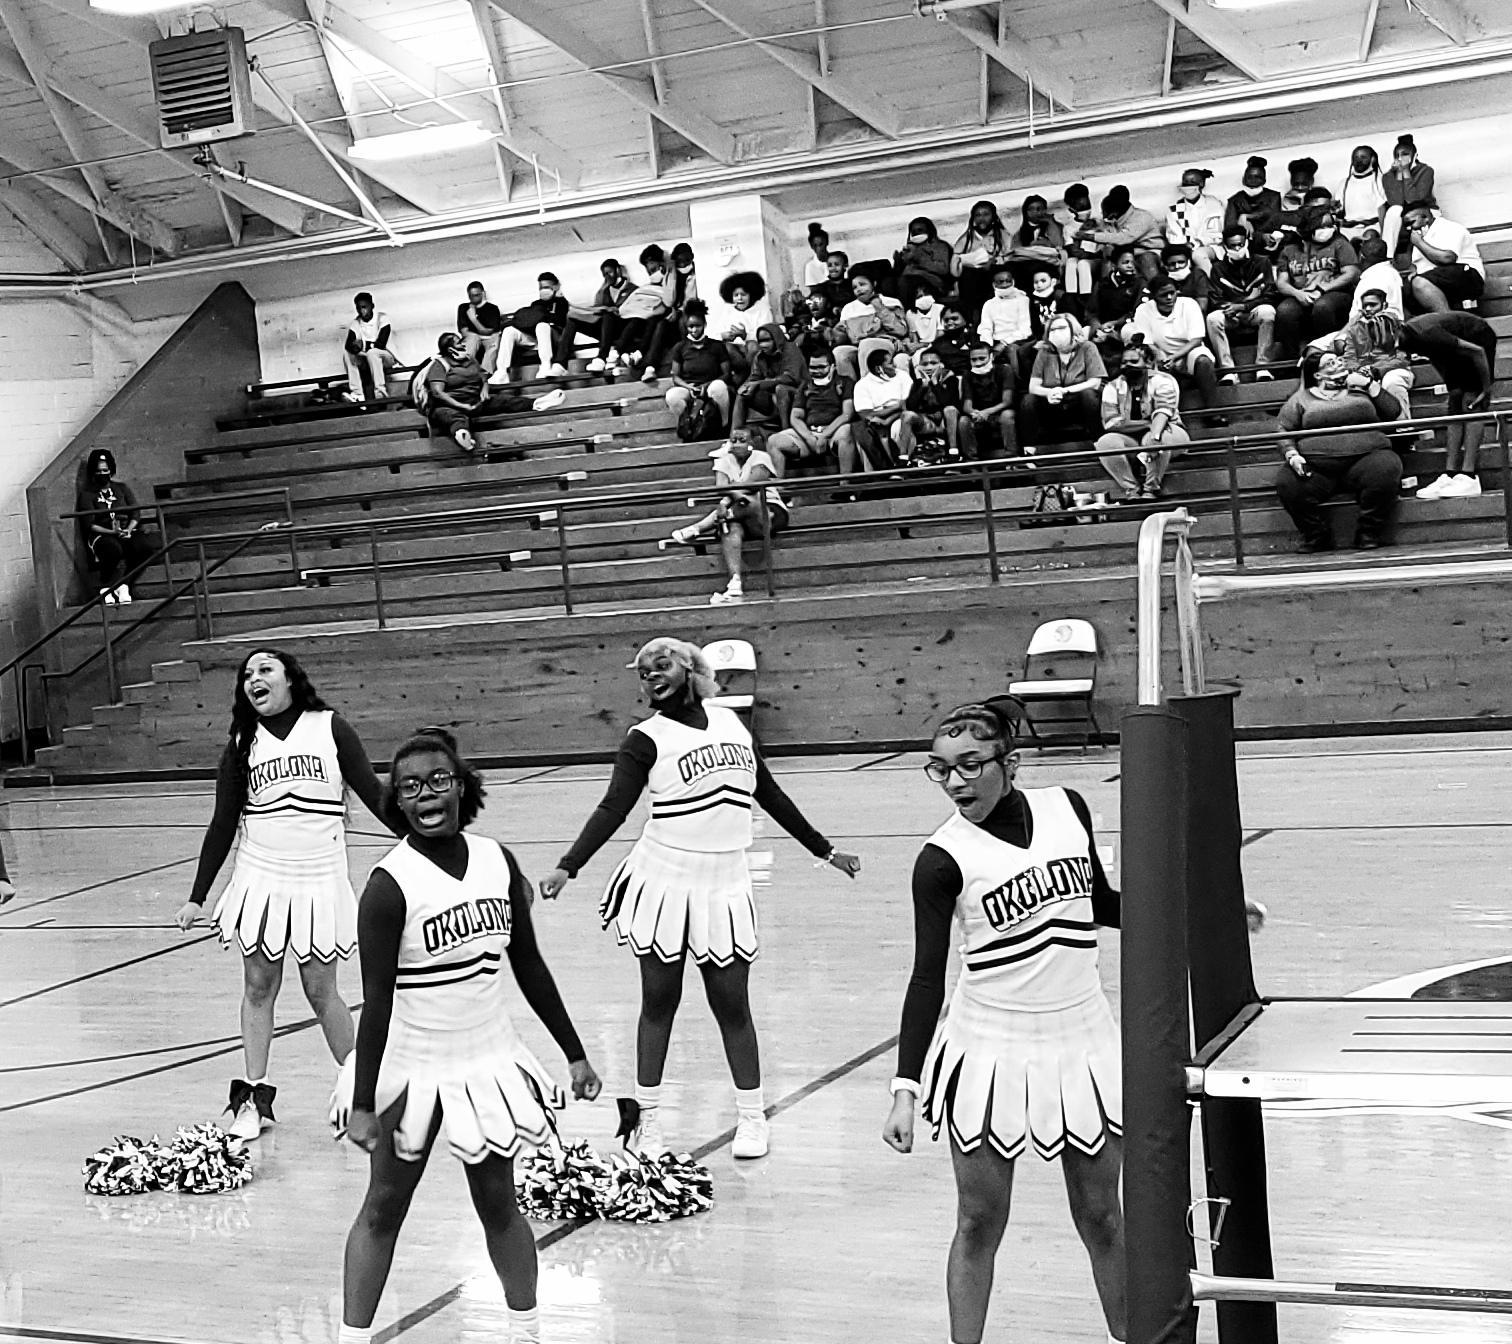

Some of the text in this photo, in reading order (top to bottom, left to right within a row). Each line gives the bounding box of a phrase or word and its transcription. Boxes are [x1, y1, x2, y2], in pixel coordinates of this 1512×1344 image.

[249, 754, 329, 796] OKOLONA
[677, 742, 756, 787] OKOLONA
[981, 856, 1094, 932] OKOLONA
[422, 898, 513, 956] OKOLONA
